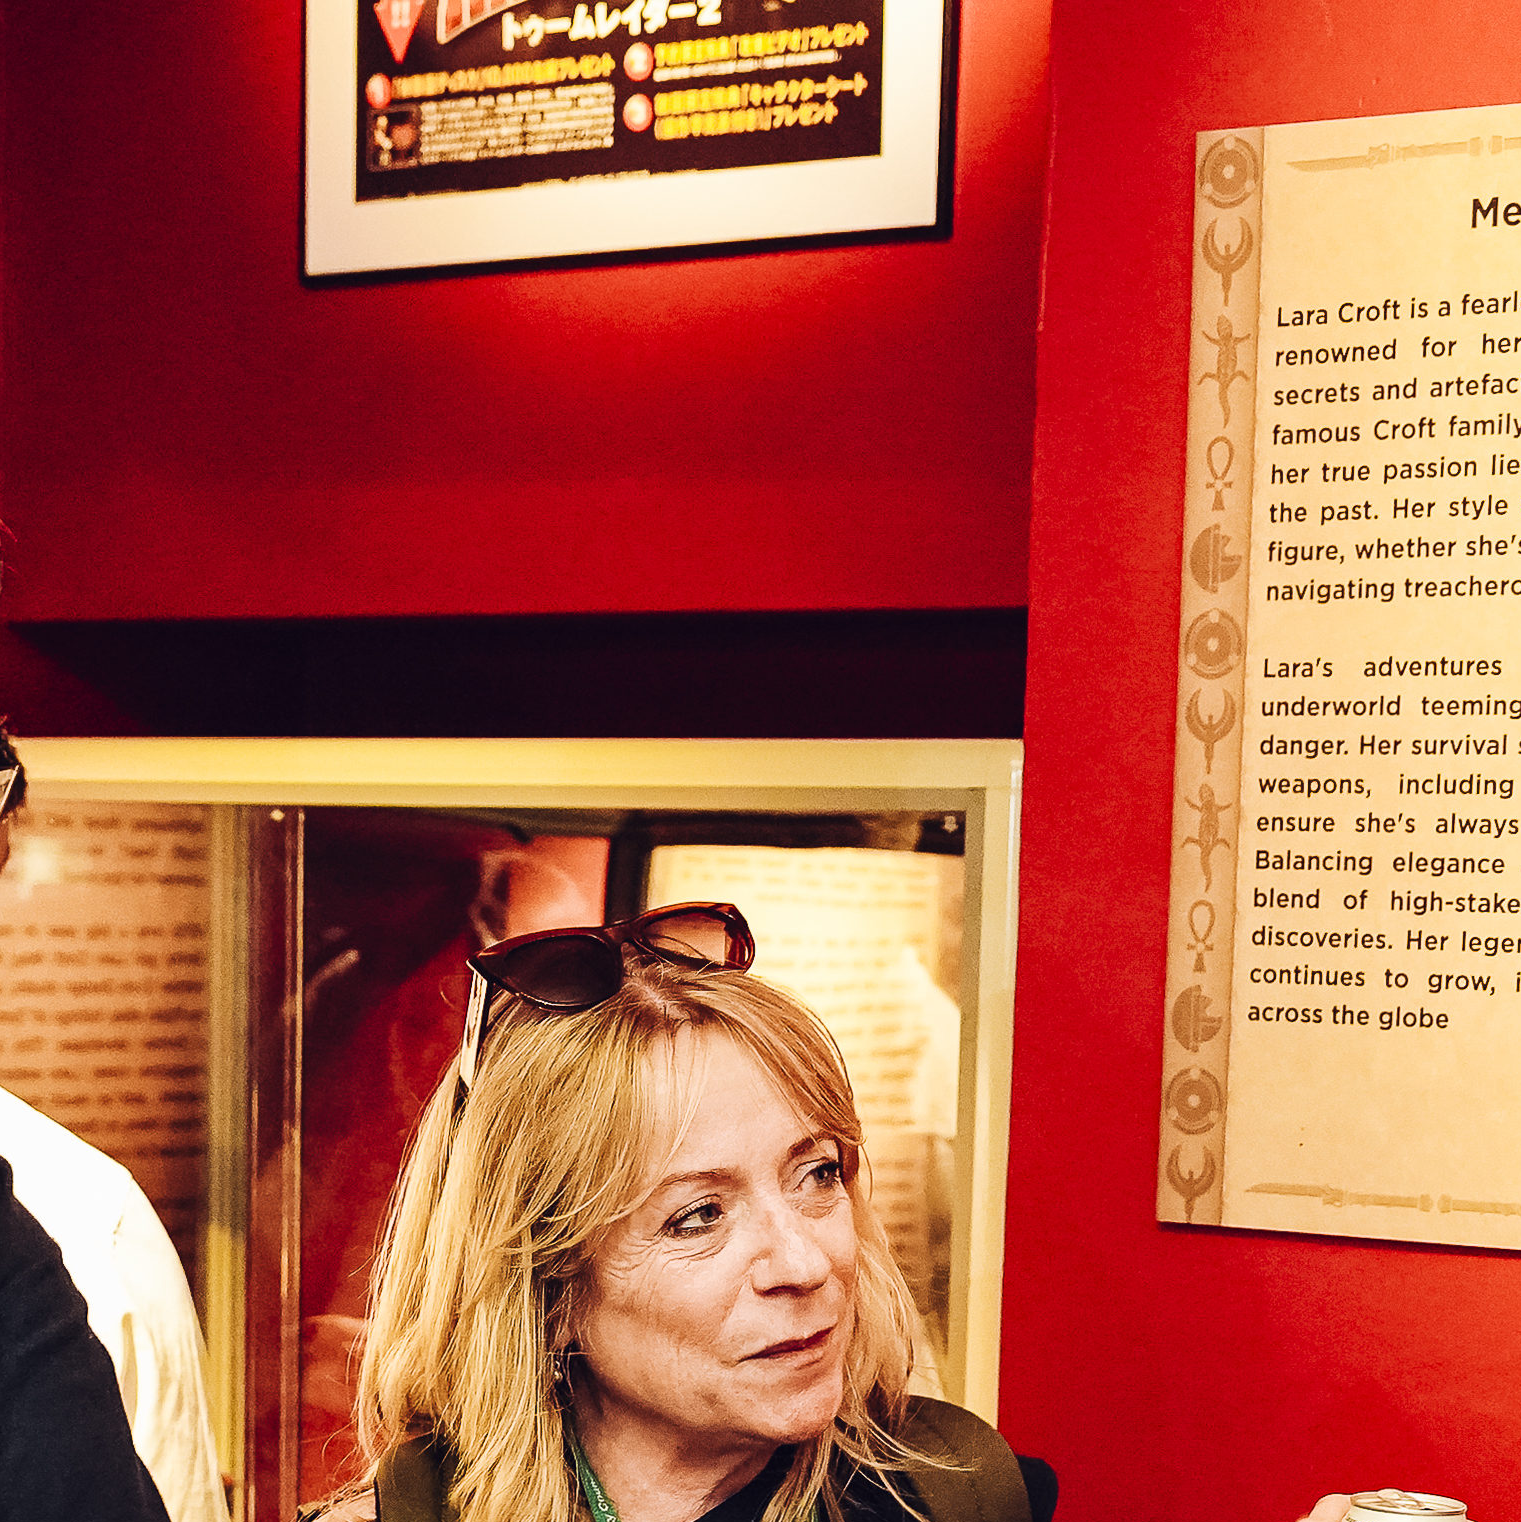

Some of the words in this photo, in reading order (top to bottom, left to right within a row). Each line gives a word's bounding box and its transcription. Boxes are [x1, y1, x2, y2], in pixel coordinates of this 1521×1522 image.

[1277, 306, 1328, 328] Lara
[1337, 298, 1401, 324] Croft
[1410, 296, 1429, 319] is
[1437, 300, 1451, 318] a
[1275, 338, 1397, 367] renowned
[1421, 335, 1458, 359] for
[1273, 382, 1361, 407] secrets
[1372, 377, 1418, 401] and
[1272, 423, 1361, 446] famous
[1373, 416, 1436, 441] Croft
[1267, 540, 1345, 566] figure,
[1354, 536, 1457, 560] whether
[1266, 577, 1395, 605] navigating
[1263, 657, 1334, 679] Lara's
[1363, 655, 1503, 678] adventures
[1261, 694, 1402, 717] underworld
[1259, 734, 1349, 760] danger.
[1359, 734, 1403, 756] Her
[1411, 733, 1508, 756] survival
[1258, 777, 1372, 799] weapons,
[1398, 773, 1515, 800] including
[1256, 816, 1336, 833] ensure
[1354, 811, 1416, 834] she's
[1435, 812, 1520, 839] always
[1255, 849, 1373, 876] Balancing
[1392, 851, 1506, 878] elegance
[1253, 887, 1321, 910] blend
[1342, 888, 1369, 911] of
[1249, 964, 1366, 987] continues
[1384, 968, 1409, 989] to
[1427, 973, 1496, 997] grow,
[1247, 1005, 1323, 1024] across
[1331, 1004, 1370, 1026] the
[1378, 1005, 1450, 1031] globe
